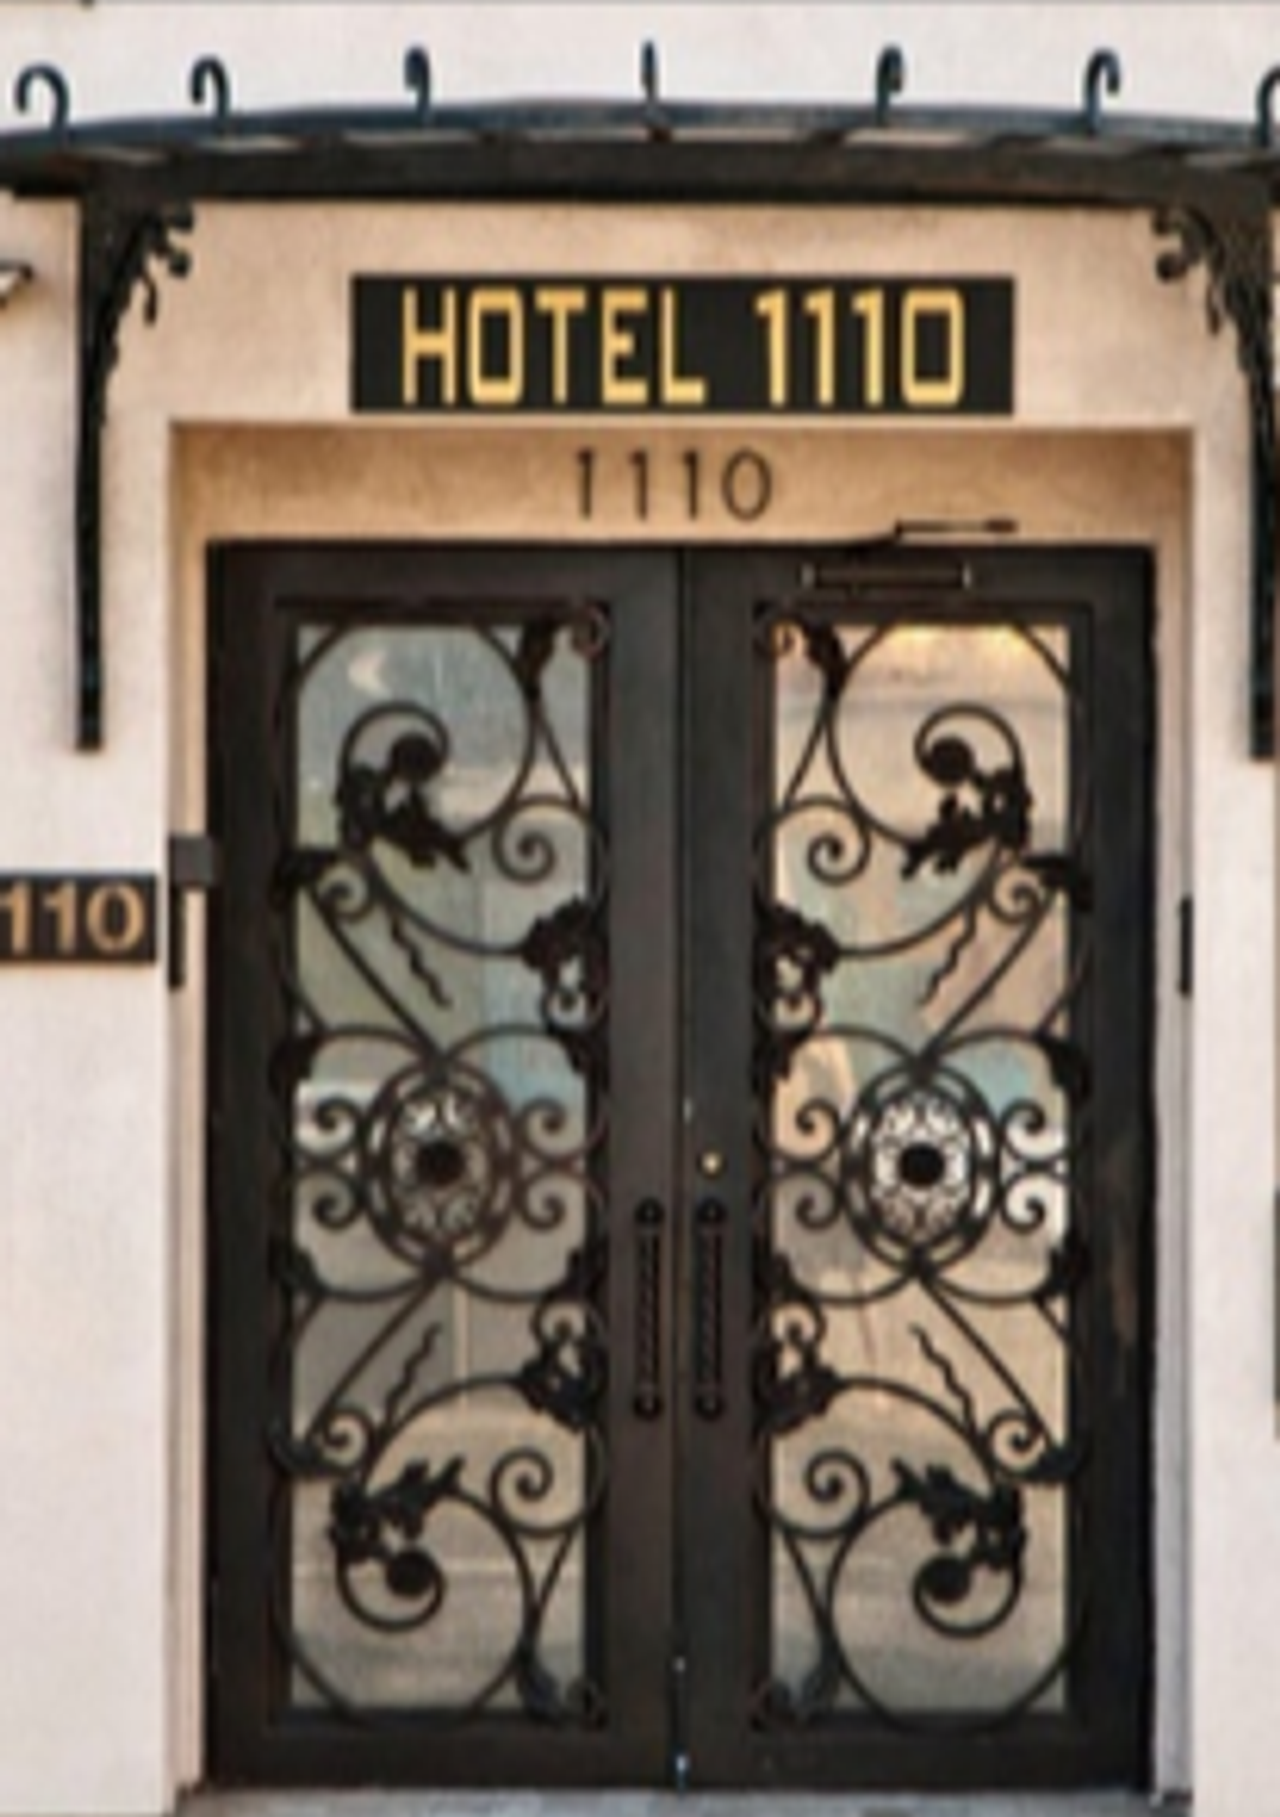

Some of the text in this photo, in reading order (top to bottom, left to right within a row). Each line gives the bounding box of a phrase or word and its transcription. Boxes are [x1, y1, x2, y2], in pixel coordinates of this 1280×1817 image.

[402, 288, 965, 406] HOTEL 1110
[577, 447, 773, 522] 1110
